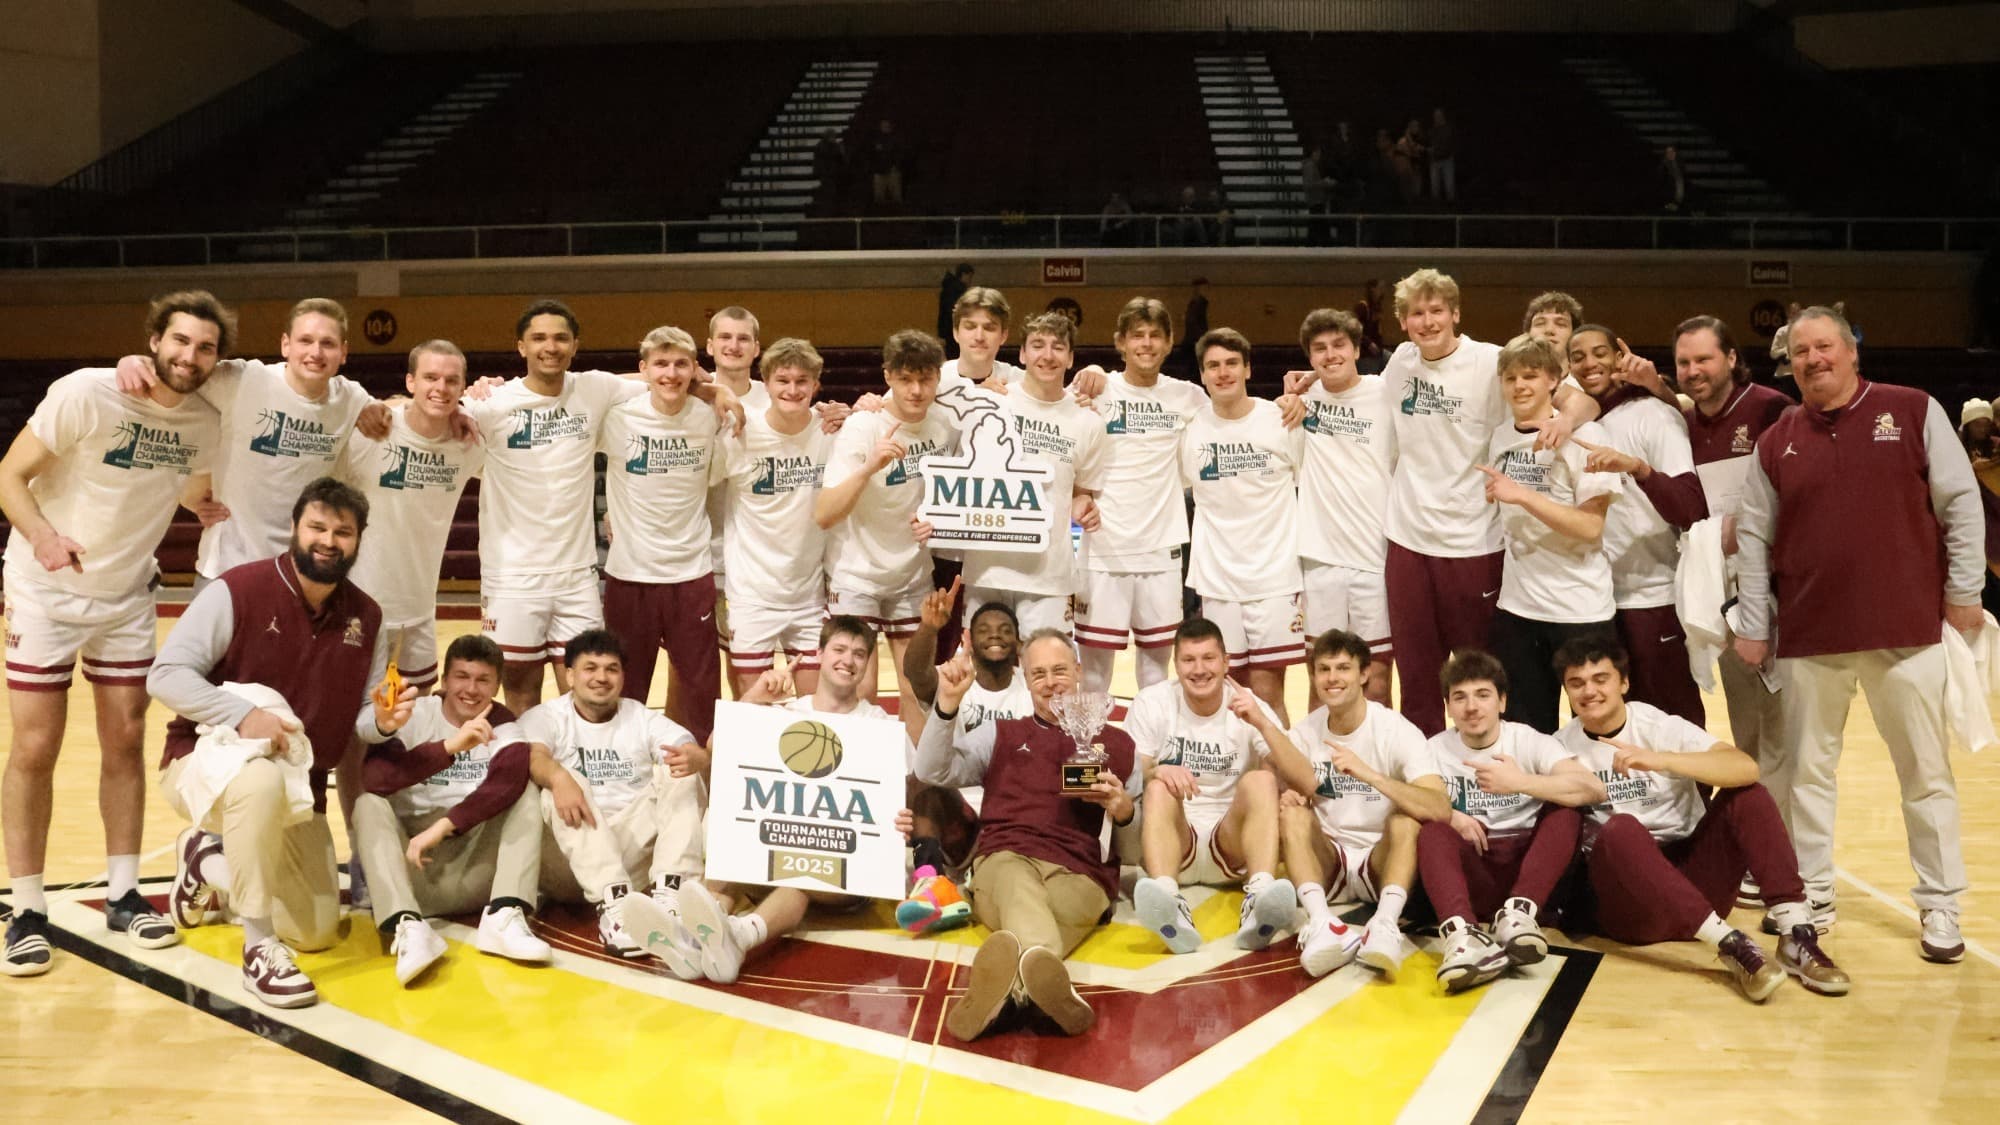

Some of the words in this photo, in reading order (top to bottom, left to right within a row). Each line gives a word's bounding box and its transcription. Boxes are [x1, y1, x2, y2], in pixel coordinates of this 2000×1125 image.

[1046, 264, 1081, 277] Calvin
[366, 318, 393, 337] 104
[534, 407, 569, 421] MIAA
[1128, 402, 1163, 413] MIAA
[1320, 404, 1354, 418] MIAA
[285, 417, 323, 434] MIAA
[533, 416, 587, 431] TOURNAMENT
[1025, 419, 1060, 436] MIAA
[1128, 420, 1173, 428] CHAMPIONS
[141, 428, 180, 445] MIAA
[534, 425, 583, 439] CHAMPIONS
[281, 440, 333, 452] CHAMPIONS
[651, 438, 688, 450] MIAA
[1023, 439, 1068, 454] CHAMPIONS
[1024, 431, 1076, 448] TOURNAMENT
[139, 442, 198, 457] TOURNAMENT
[650, 449, 704, 459] TOURNAMENT
[1219, 442, 1254, 455] MIAA
[135, 451, 188, 465] CHAMPIONS
[410, 451, 445, 466] MIAA
[650, 458, 699, 466] CHAMPIONS
[776, 456, 811, 469] MIAA
[1219, 453, 1272, 463] TOURNAMENT
[409, 464, 459, 476] TOURNAMENT
[1220, 461, 1267, 471] CHAMPIONS
[407, 473, 453, 483] CHAMPIONS
[933, 475, 1042, 511] MIAA
[965, 513, 1006, 528] 1888
[932, 530, 969, 539] AMERICA'S
[971, 532, 991, 540] FIRST
[992, 533, 1038, 543] CONFERENCE
[1186, 740, 1221, 755] MIAA
[586, 749, 620, 761] MIAA
[1185, 753, 1240, 763] TOURNAMENT
[742, 777, 876, 825] MIAA
[1468, 797, 1520, 808] CHAMPIONS
[763, 821, 853, 841] TOURNAMENT
[768, 832, 848, 851] CHAMPIONS
[782, 855, 835, 876] 2025
